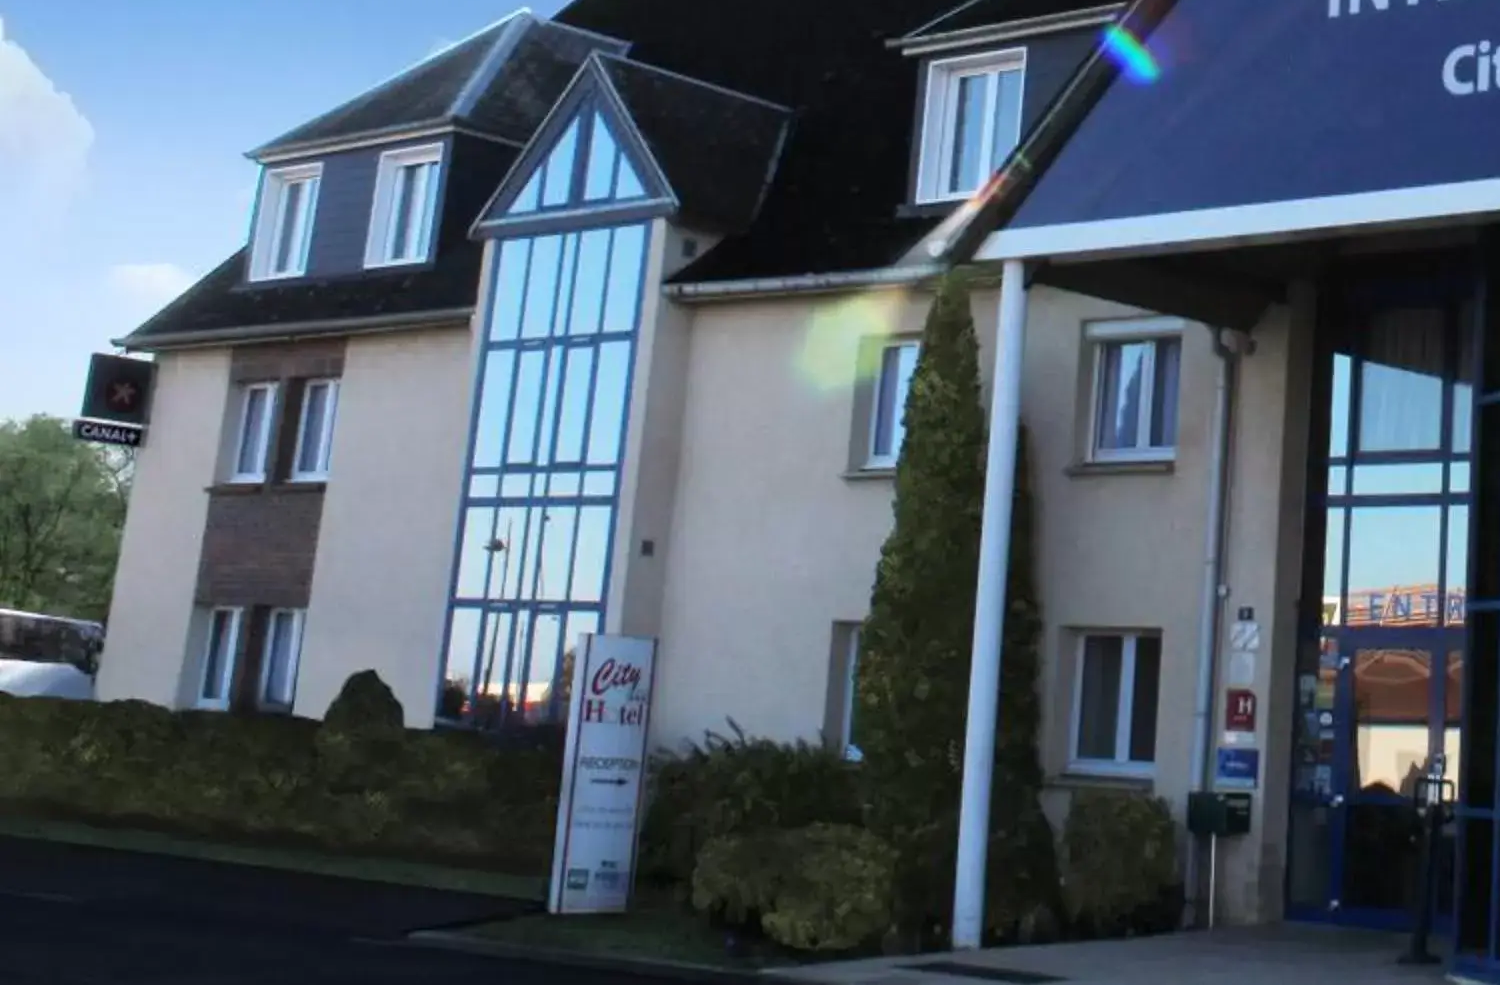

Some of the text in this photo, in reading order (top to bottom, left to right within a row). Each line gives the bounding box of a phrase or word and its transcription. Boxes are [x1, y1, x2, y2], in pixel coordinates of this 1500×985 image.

[81, 421, 137, 443] CANAL+
[592, 657, 641, 696] City
[585, 699, 643, 725] Htel
